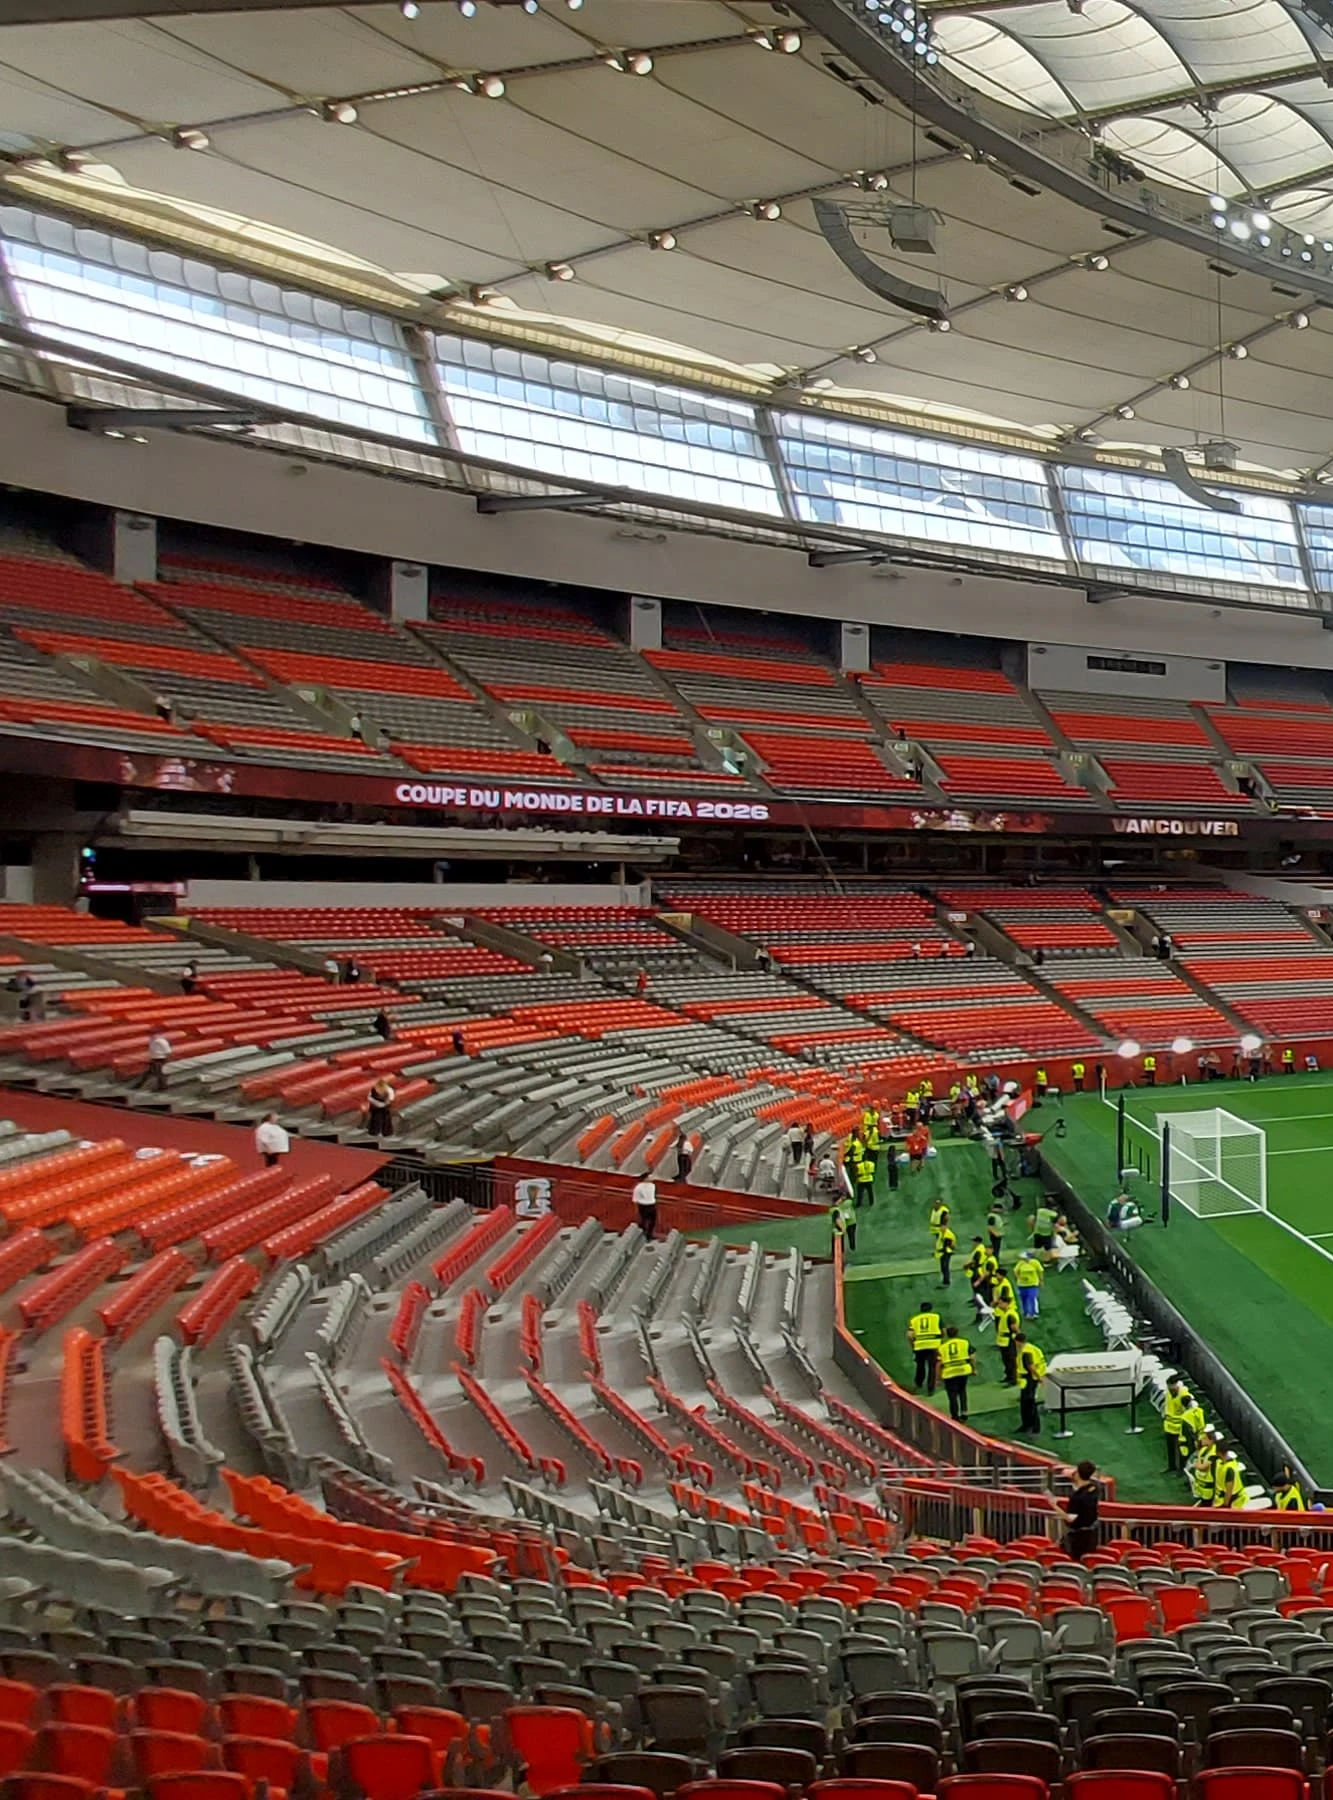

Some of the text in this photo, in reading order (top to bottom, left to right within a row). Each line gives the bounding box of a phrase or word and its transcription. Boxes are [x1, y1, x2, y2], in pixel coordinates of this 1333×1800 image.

[396, 784, 769, 820] COUPE DU MONDE DE LA FIFA 2026
[1112, 819, 1238, 835] VANCOUVER
